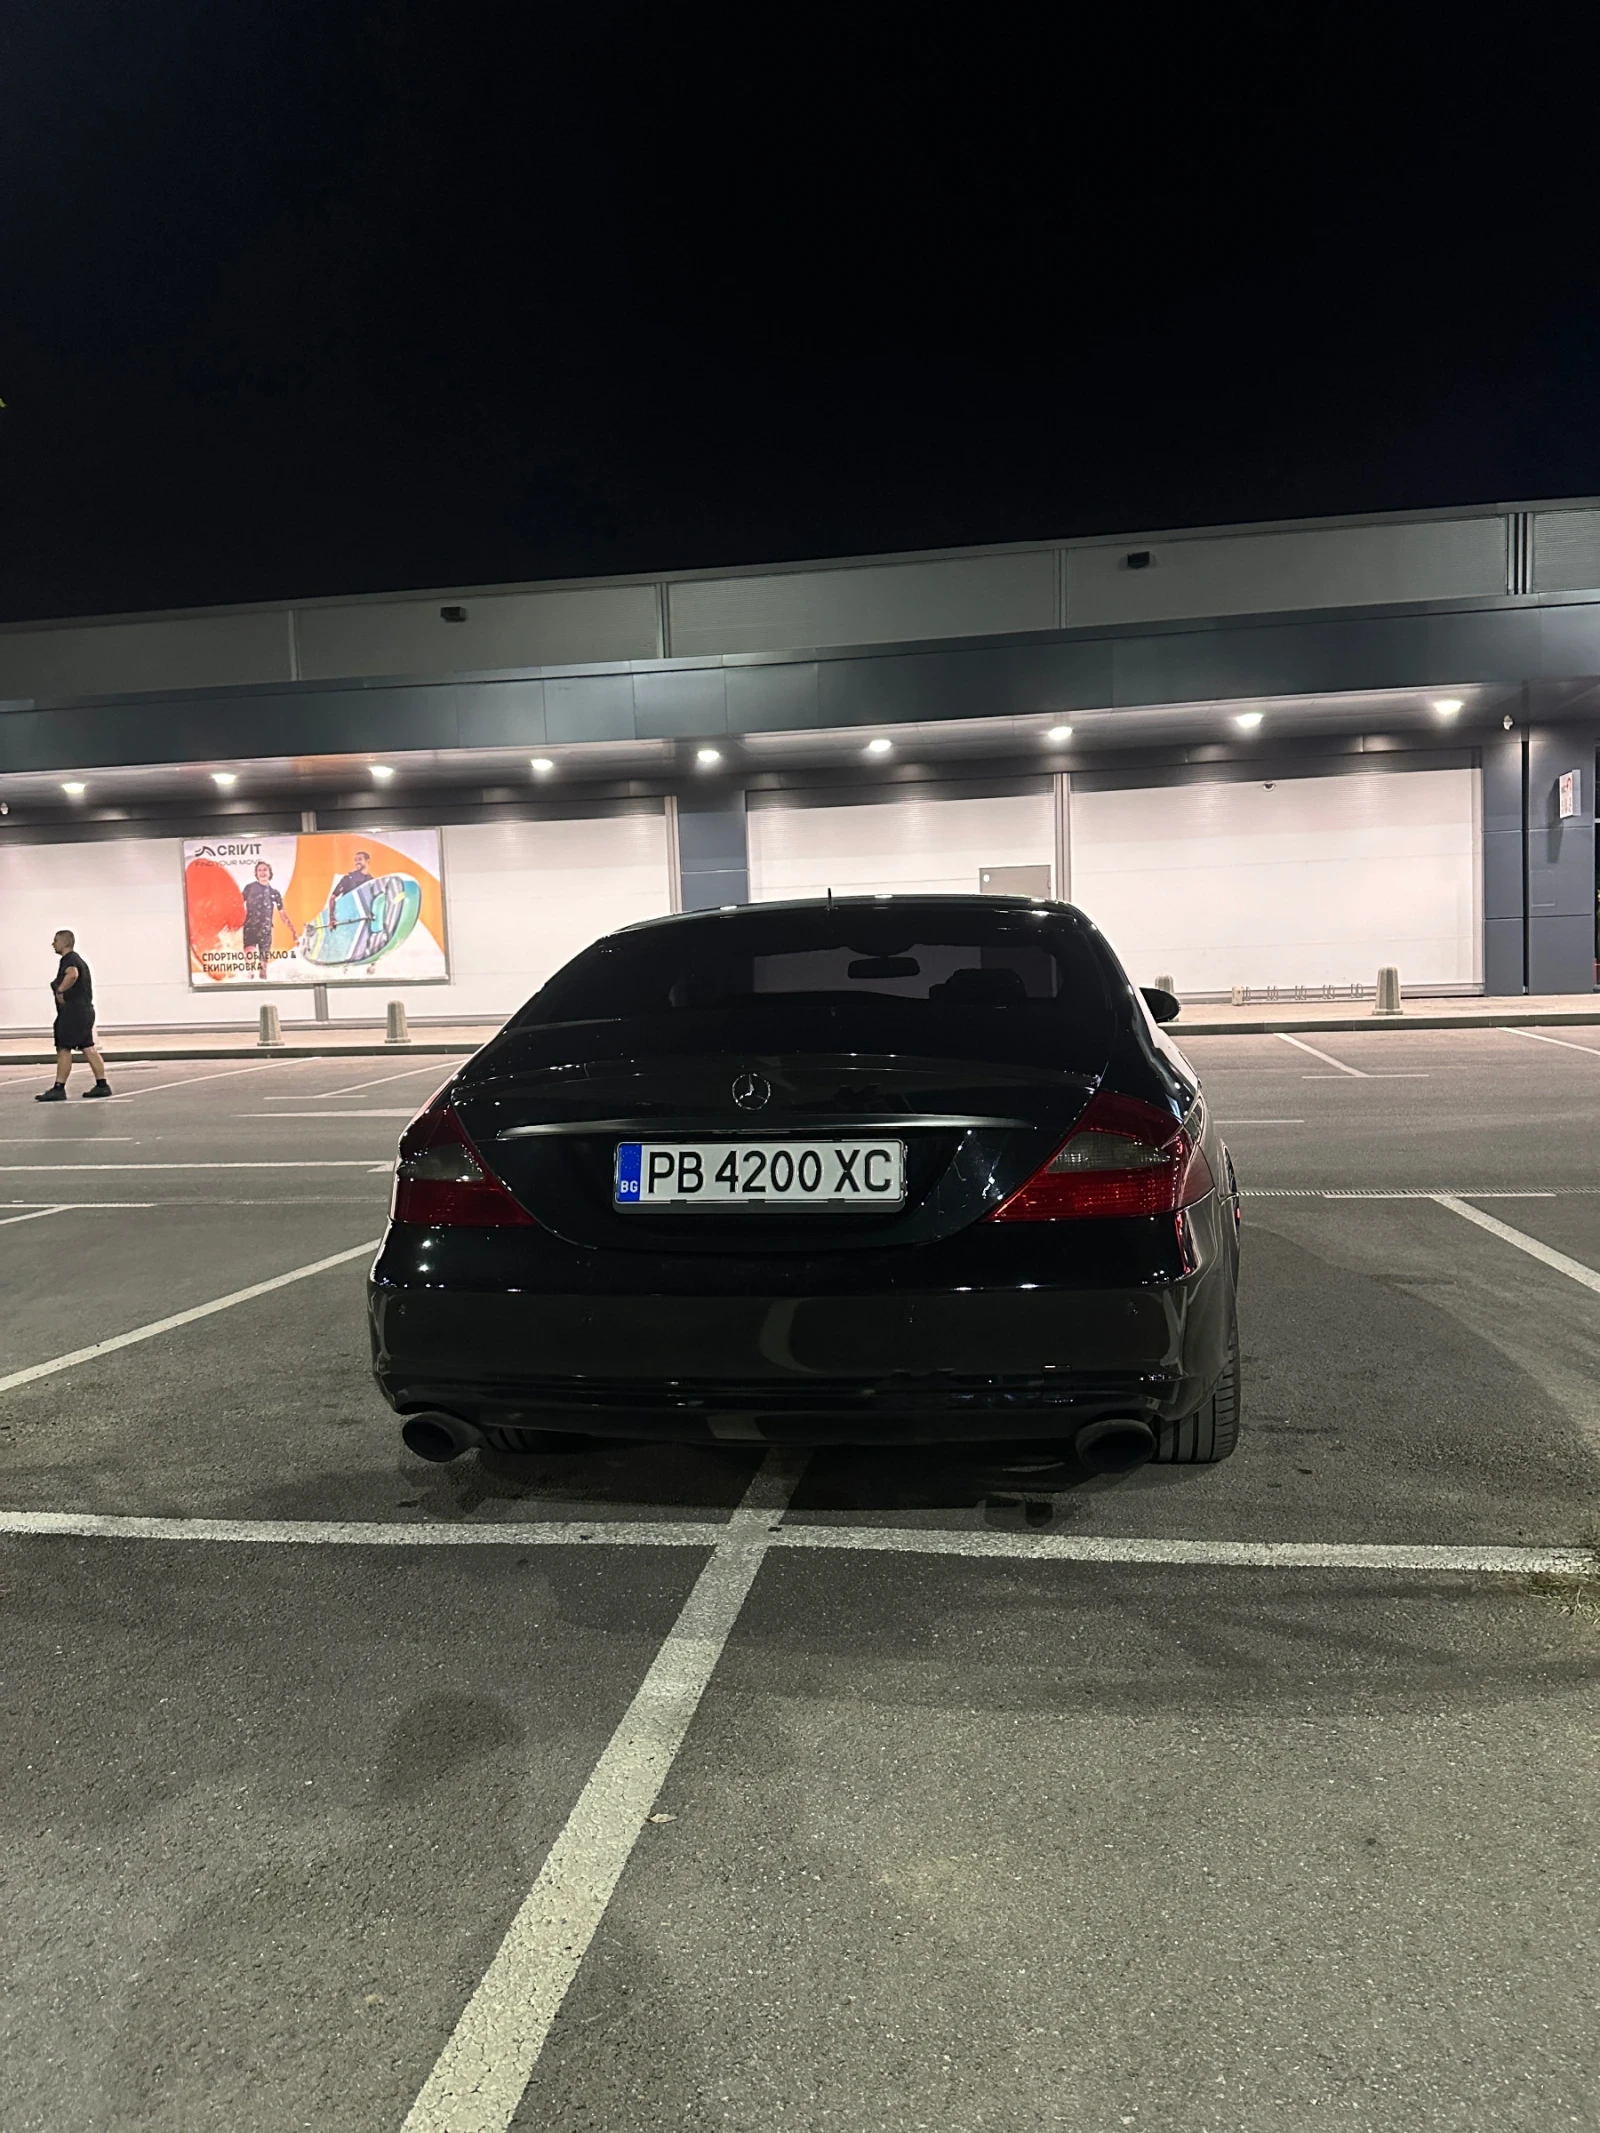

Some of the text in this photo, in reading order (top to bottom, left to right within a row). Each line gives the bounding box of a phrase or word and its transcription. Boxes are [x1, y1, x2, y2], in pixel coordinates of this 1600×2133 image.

[217, 844, 262, 856] CRIVIT
[202, 951, 297, 961] СПОРТНО ОБЛЕКЛО &
[203, 962, 263, 972] ЕКИПИРОВКА
[648, 1149, 892, 1194] PB 4200 XC
[620, 1181, 639, 1193] BG
